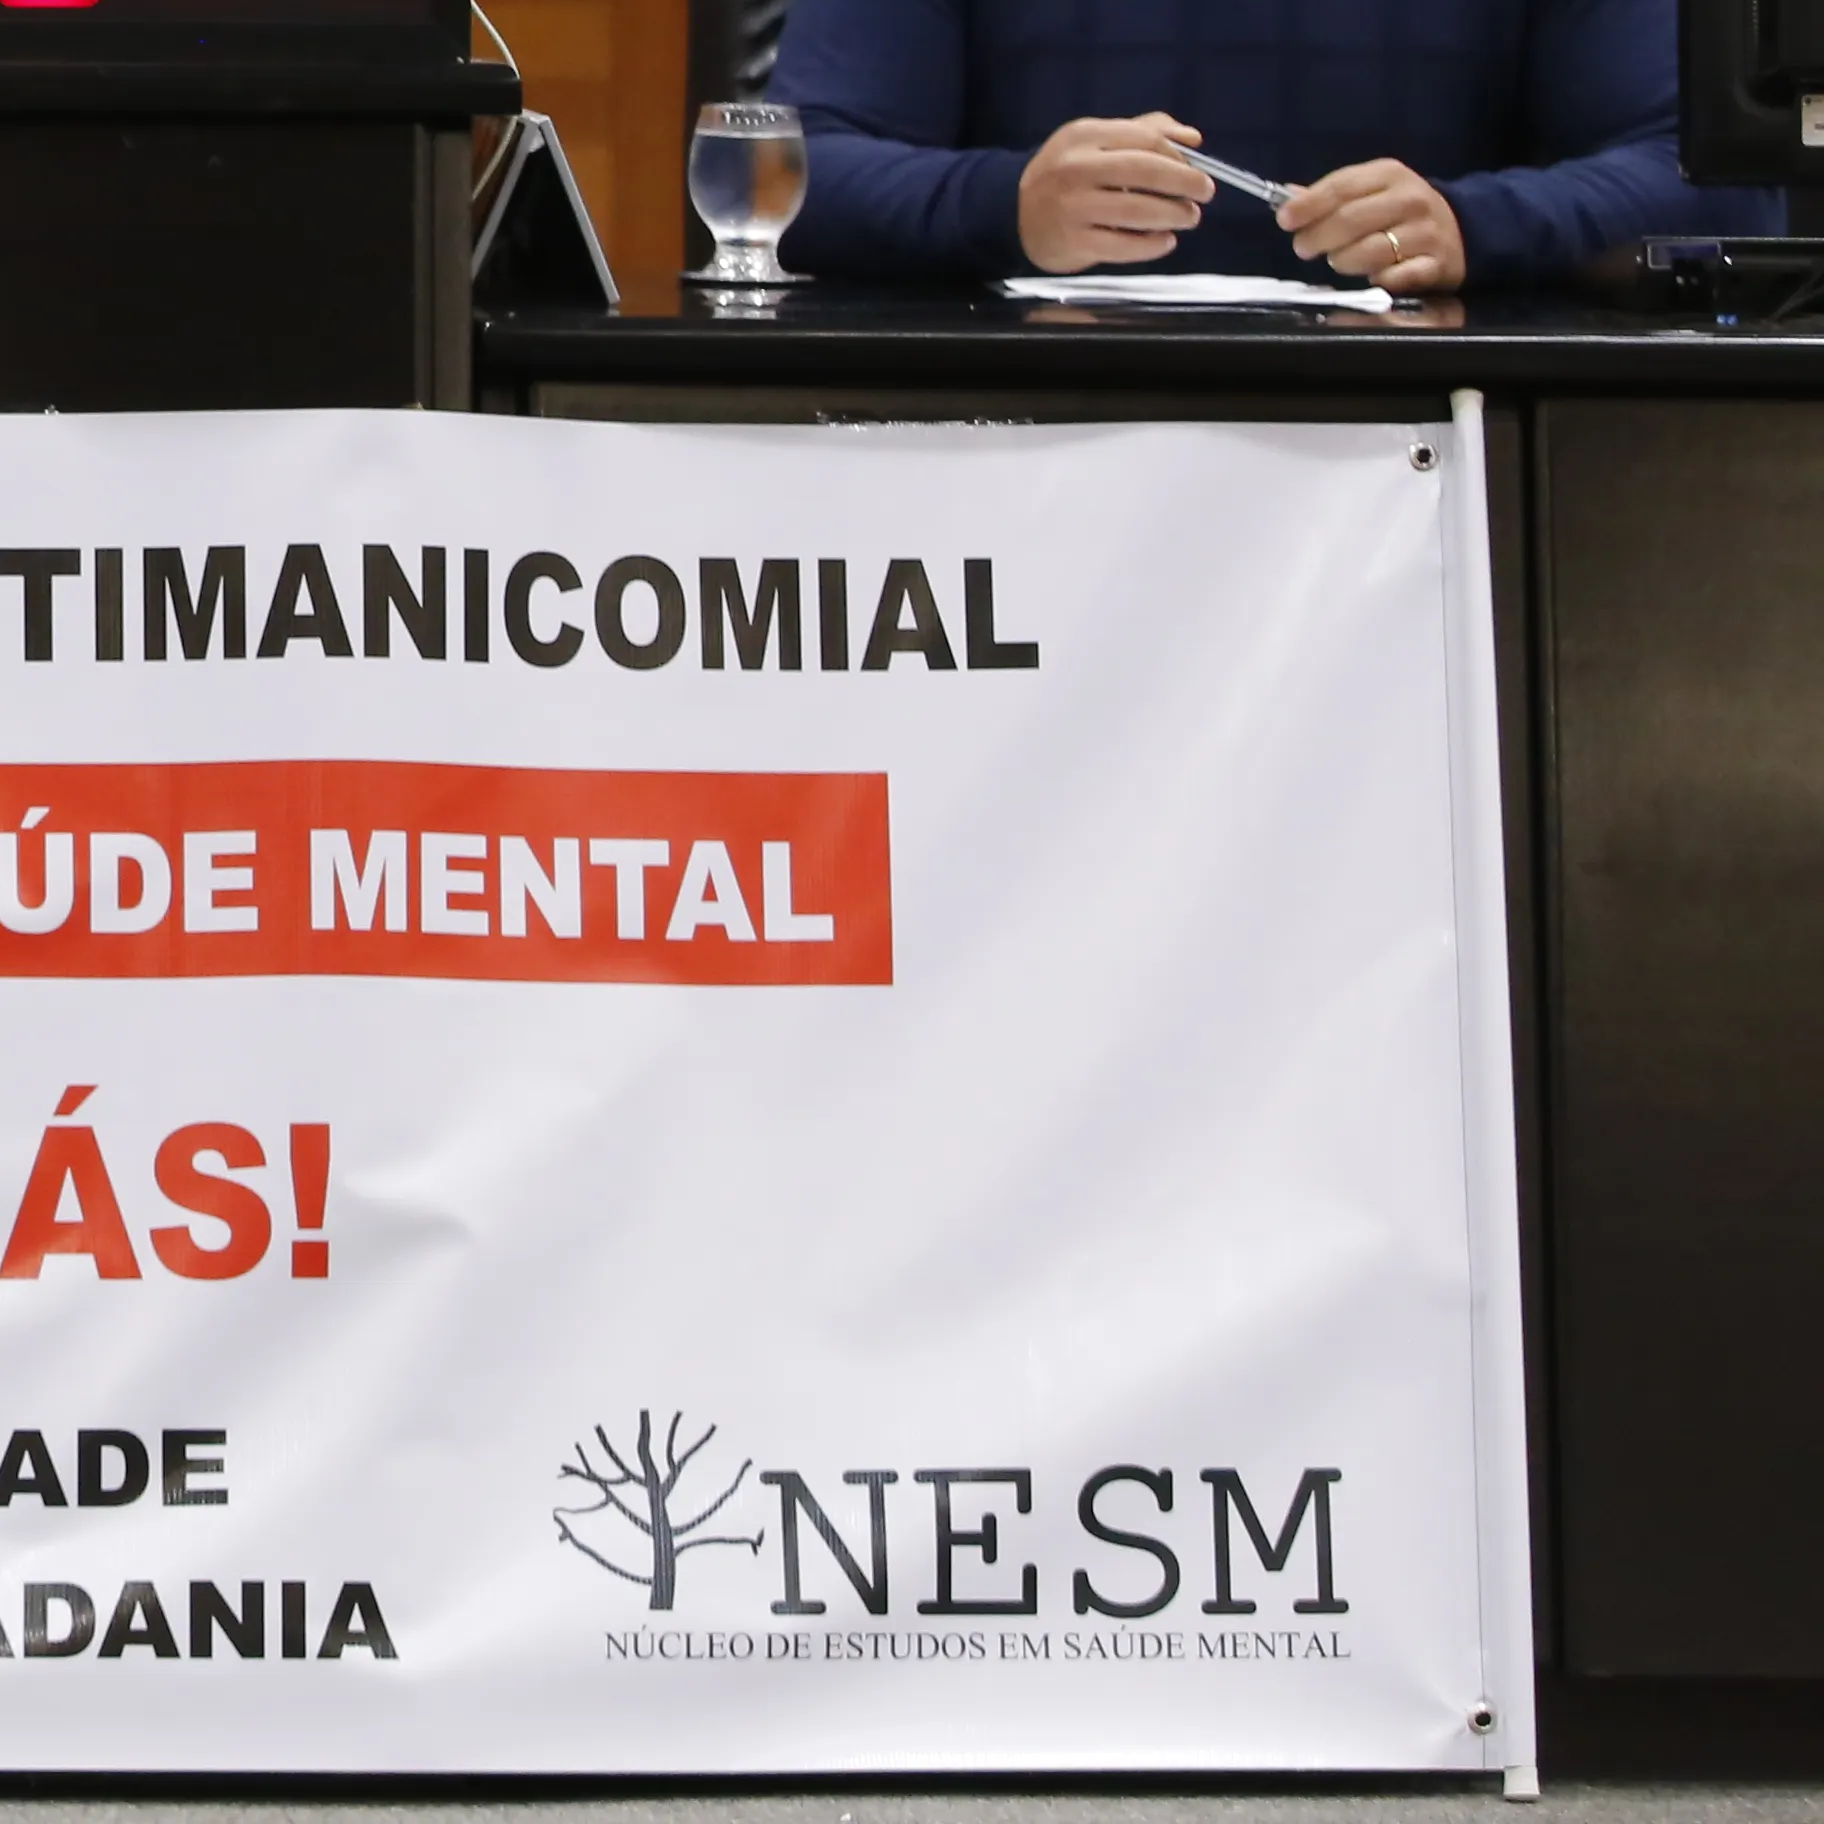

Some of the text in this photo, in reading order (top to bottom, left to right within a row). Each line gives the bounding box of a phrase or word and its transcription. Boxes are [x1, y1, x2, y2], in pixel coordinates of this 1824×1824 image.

[310, 829, 835, 942] MENTAL
[760, 1464, 1350, 1616] NESM
[605, 1625, 1352, 1660] NÚCLEO DE ESTUDOS EM SAÚDE MENTAL
